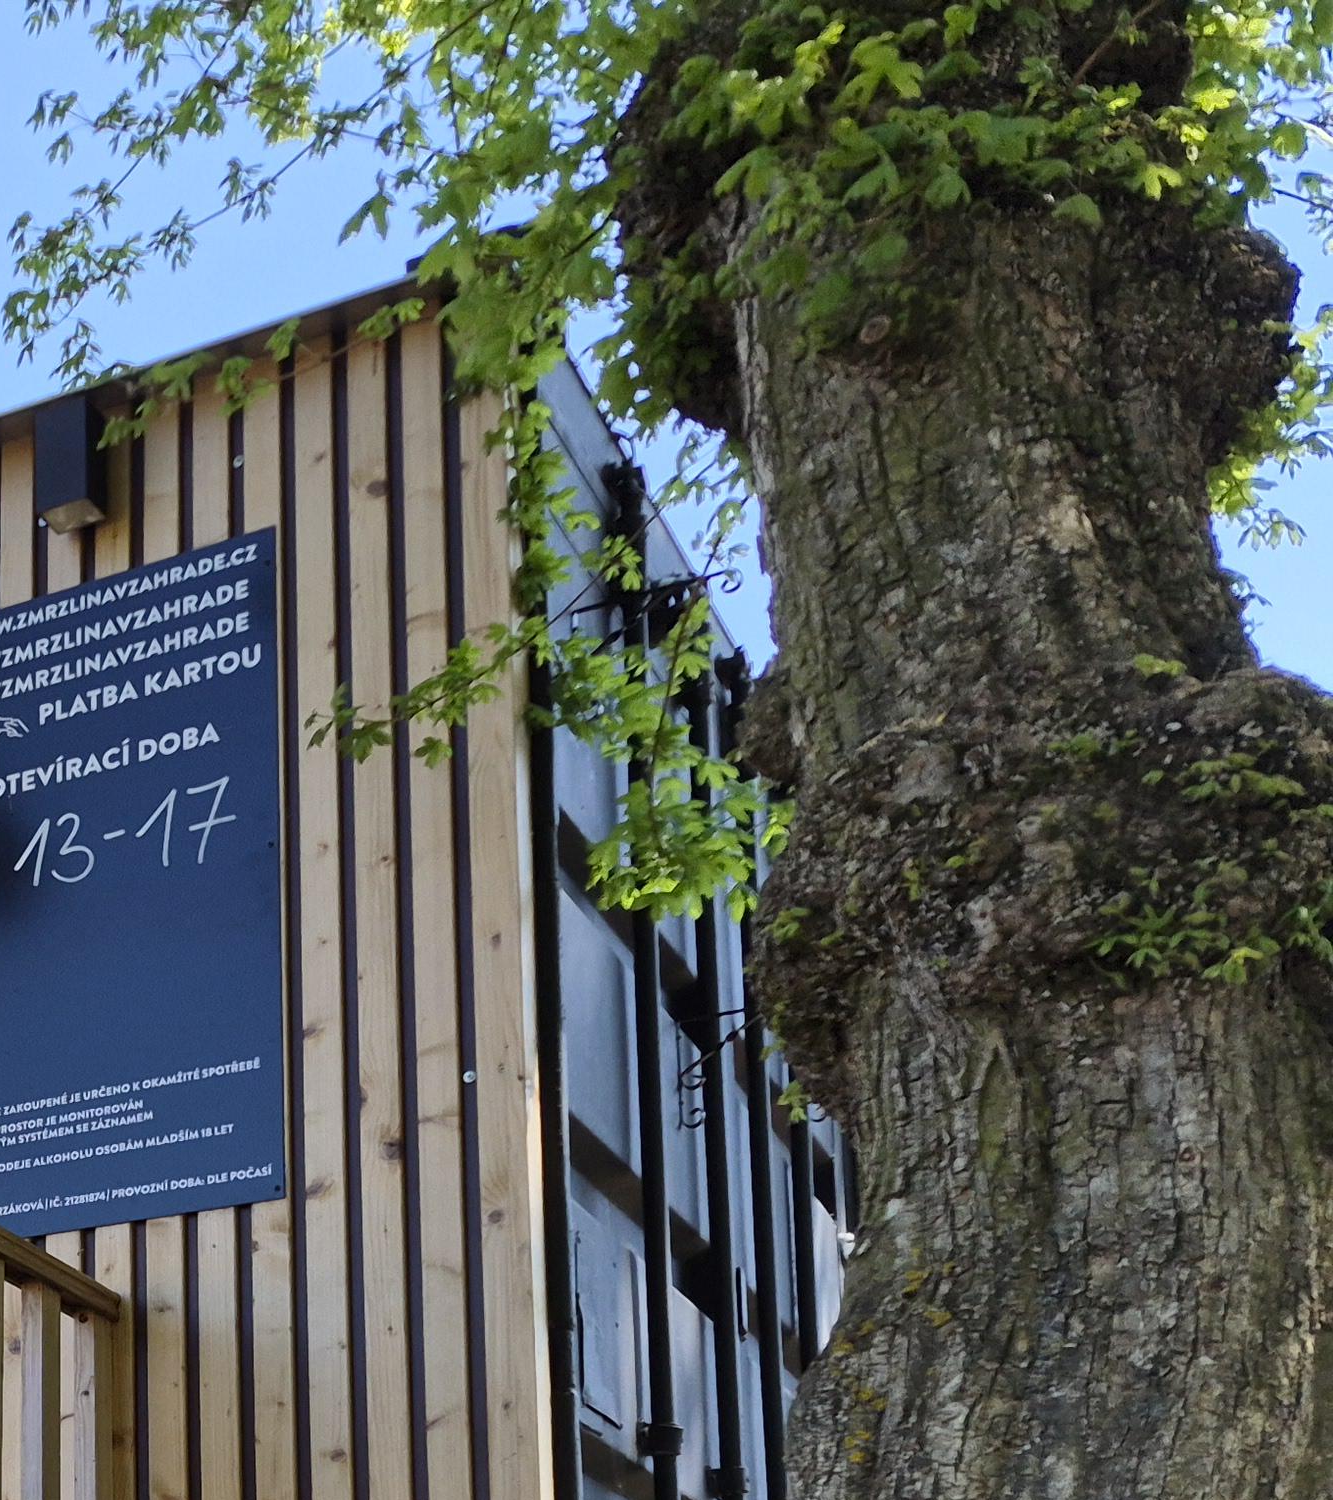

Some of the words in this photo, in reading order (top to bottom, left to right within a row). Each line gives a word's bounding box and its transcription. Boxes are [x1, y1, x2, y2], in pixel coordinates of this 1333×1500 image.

[39, 680, 139, 725] PLATBA
[144, 643, 262, 696] KARTOU
[138, 722, 220, 761] DOBA
[3, 1092, 68, 1115] ZAKOUPENÉ
[69, 1092, 81, 1103] JE
[83, 1083, 130, 1101] URČENO
[133, 1082, 140, 1091] K
[142, 1067, 200, 1089] OKAMŽITÉ
[18, 1126, 74, 1144] SYSTÉMEM
[76, 1123, 89, 1133] SE
[91, 1111, 153, 1131] ZÁZNAMEM
[45, 1115, 56, 1126] JE
[59, 1099, 144, 1126] MONITOROVÁN
[33, 1148, 93, 1167] ALKOHOLU
[95, 1139, 143, 1156] OSOBÁM
[145, 1128, 199, 1147] MLADŠÍM
[201, 1129, 212, 1138] 18
[214, 1123, 234, 1135] LET
[112, 1180, 168, 1199] PROVOZNÍ
[170, 1176, 204, 1190] DOBA:
[207, 1172, 228, 1185] DLE
[230, 1163, 272, 1181] POČASÍ
